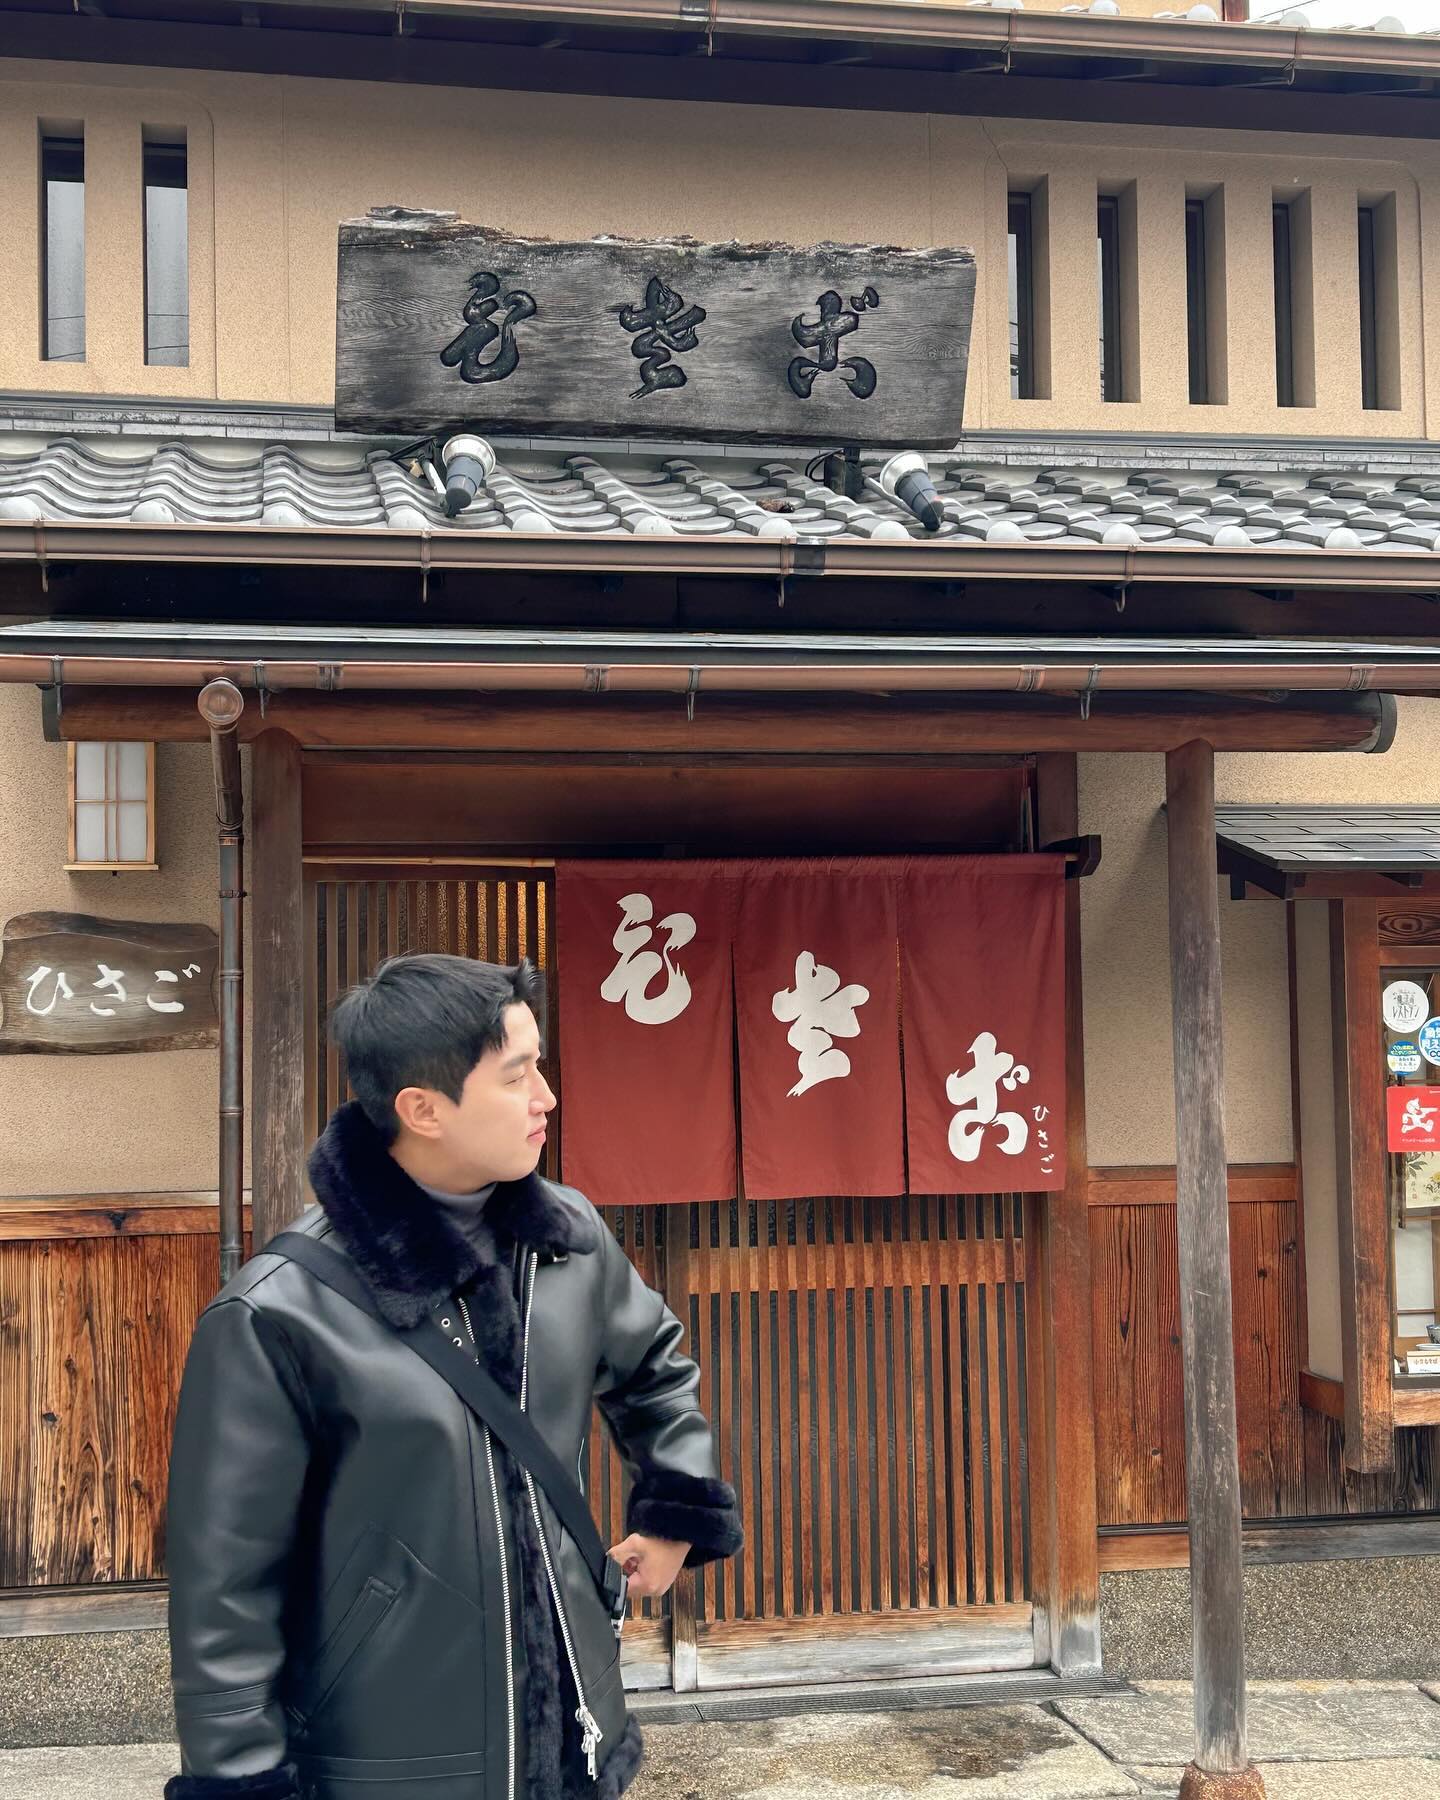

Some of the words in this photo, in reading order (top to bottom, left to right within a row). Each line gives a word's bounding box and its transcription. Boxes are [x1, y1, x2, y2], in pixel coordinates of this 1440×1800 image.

[26, 963, 201, 1016] ひさご
[1032, 1105, 1055, 1174] ひさご
